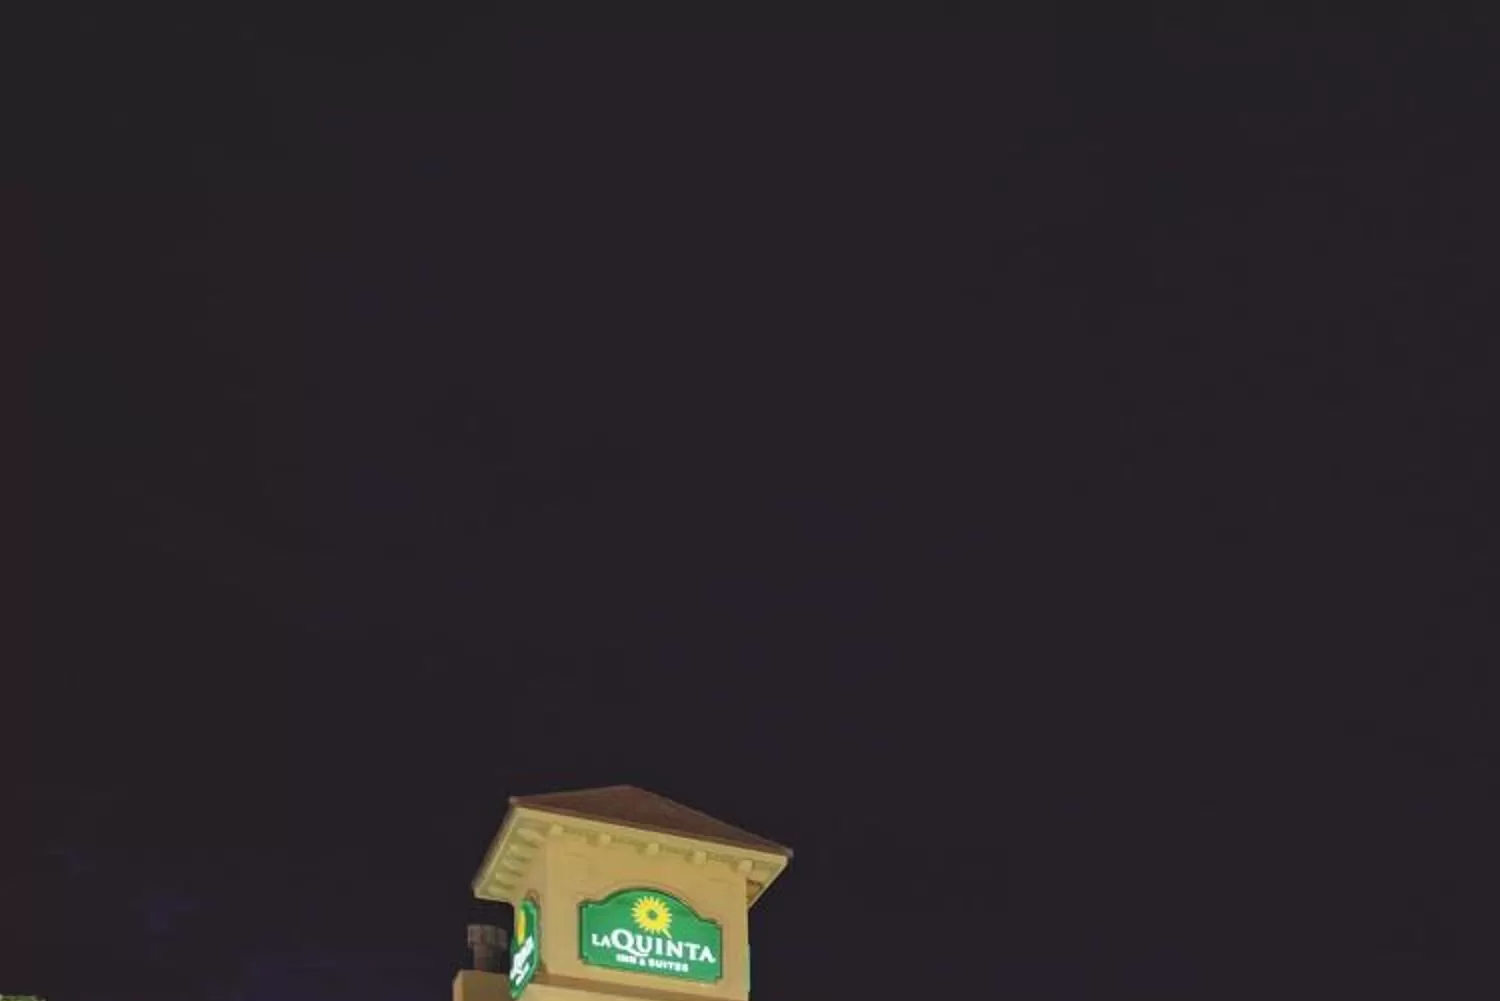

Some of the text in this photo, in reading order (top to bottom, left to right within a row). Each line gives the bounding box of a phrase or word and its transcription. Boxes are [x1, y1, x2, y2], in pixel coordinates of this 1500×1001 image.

[591, 928, 717, 964] LA QUINTA
[616, 953, 637, 965] INN
[648, 958, 689, 973] SUITES
